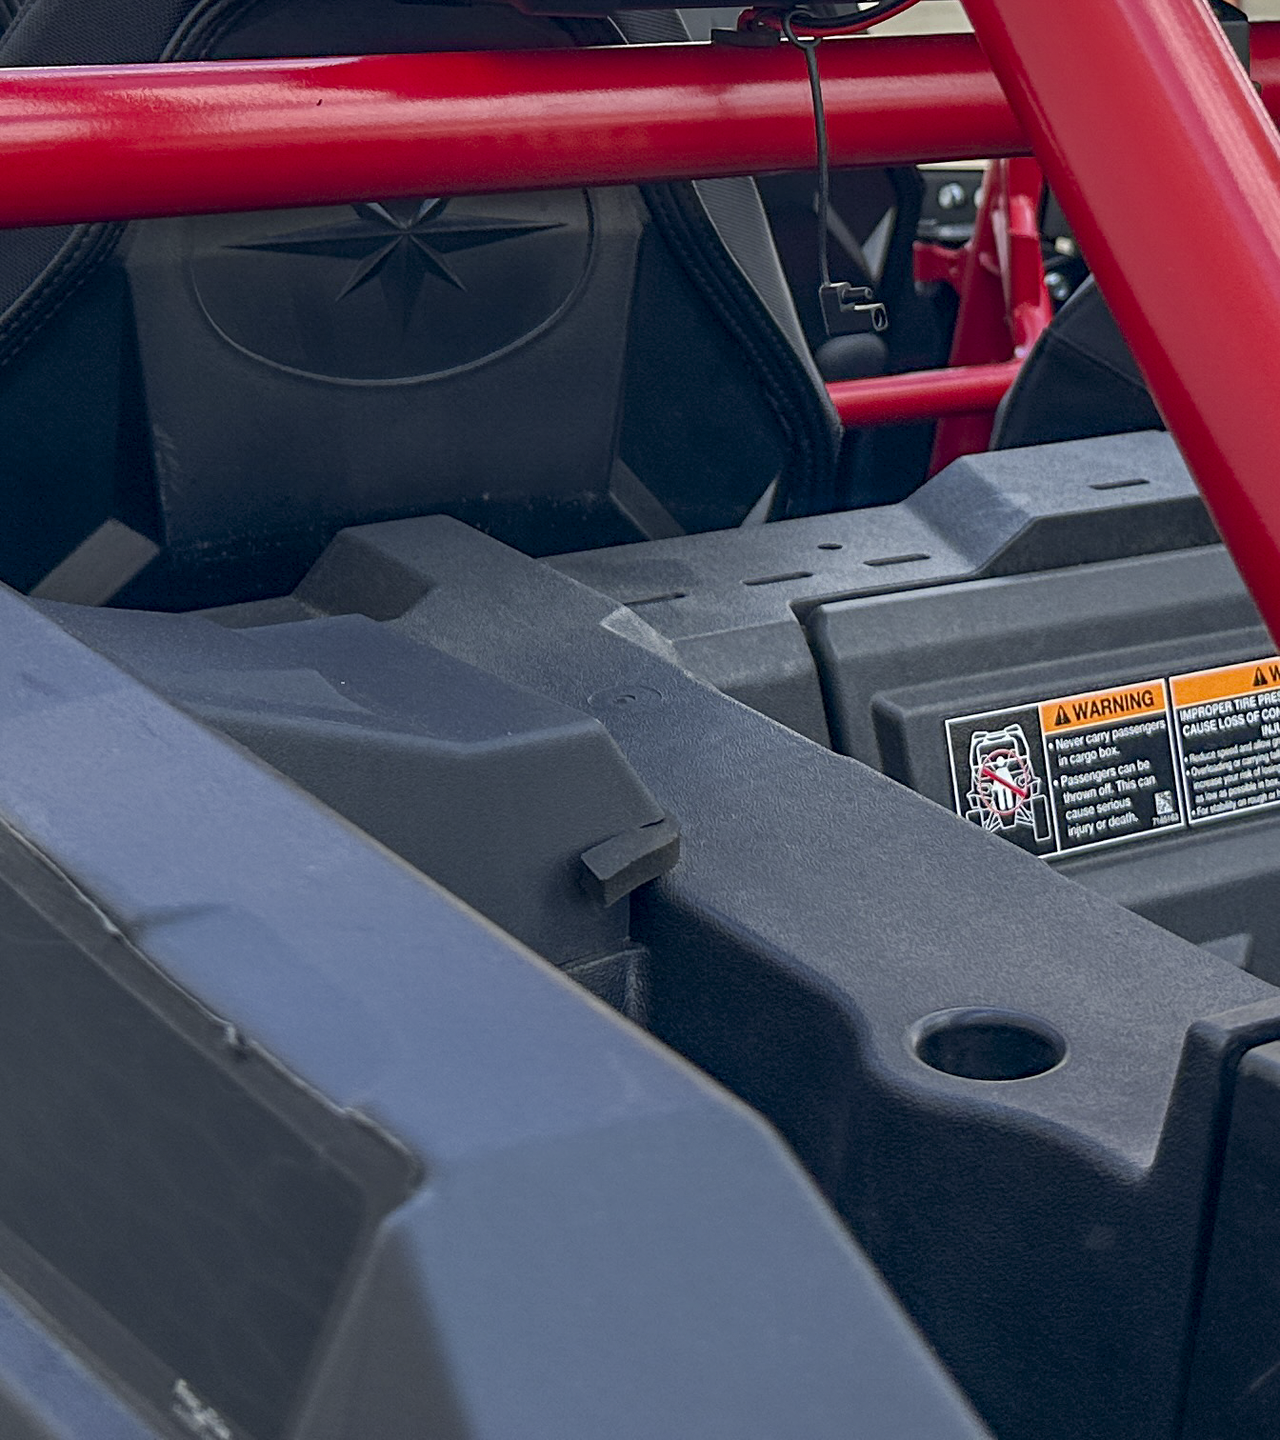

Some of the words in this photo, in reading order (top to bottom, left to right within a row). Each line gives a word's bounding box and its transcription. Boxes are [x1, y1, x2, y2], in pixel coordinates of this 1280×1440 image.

[1072, 690, 1154, 720] WARNING
[1179, 700, 1232, 721] IMPROPER
[1233, 696, 1257, 710] TIRE
[1054, 734, 1084, 750] Never
[1085, 731, 1111, 746] carry
[1111, 719, 1166, 741] passengers
[1182, 719, 1217, 736] CAUSE
[1217, 714, 1245, 729] LOSS
[1245, 711, 1261, 722] OF
[1057, 754, 1068, 766] in
[1068, 750, 1098, 766] cargo
[1098, 744, 1120, 757] box.
[1059, 764, 1117, 788] Passengers
[1117, 763, 1136, 775] can
[1136, 757, 1150, 770] be
[1062, 787, 1097, 803] thrown
[1115, 777, 1137, 792] This
[1137, 775, 1156, 787] can
[1064, 806, 1095, 819] cause
[1095, 795, 1131, 812] serious
[1066, 820, 1095, 838] injury
[1095, 819, 1107, 830] or
[1107, 811, 1138, 827] death.
